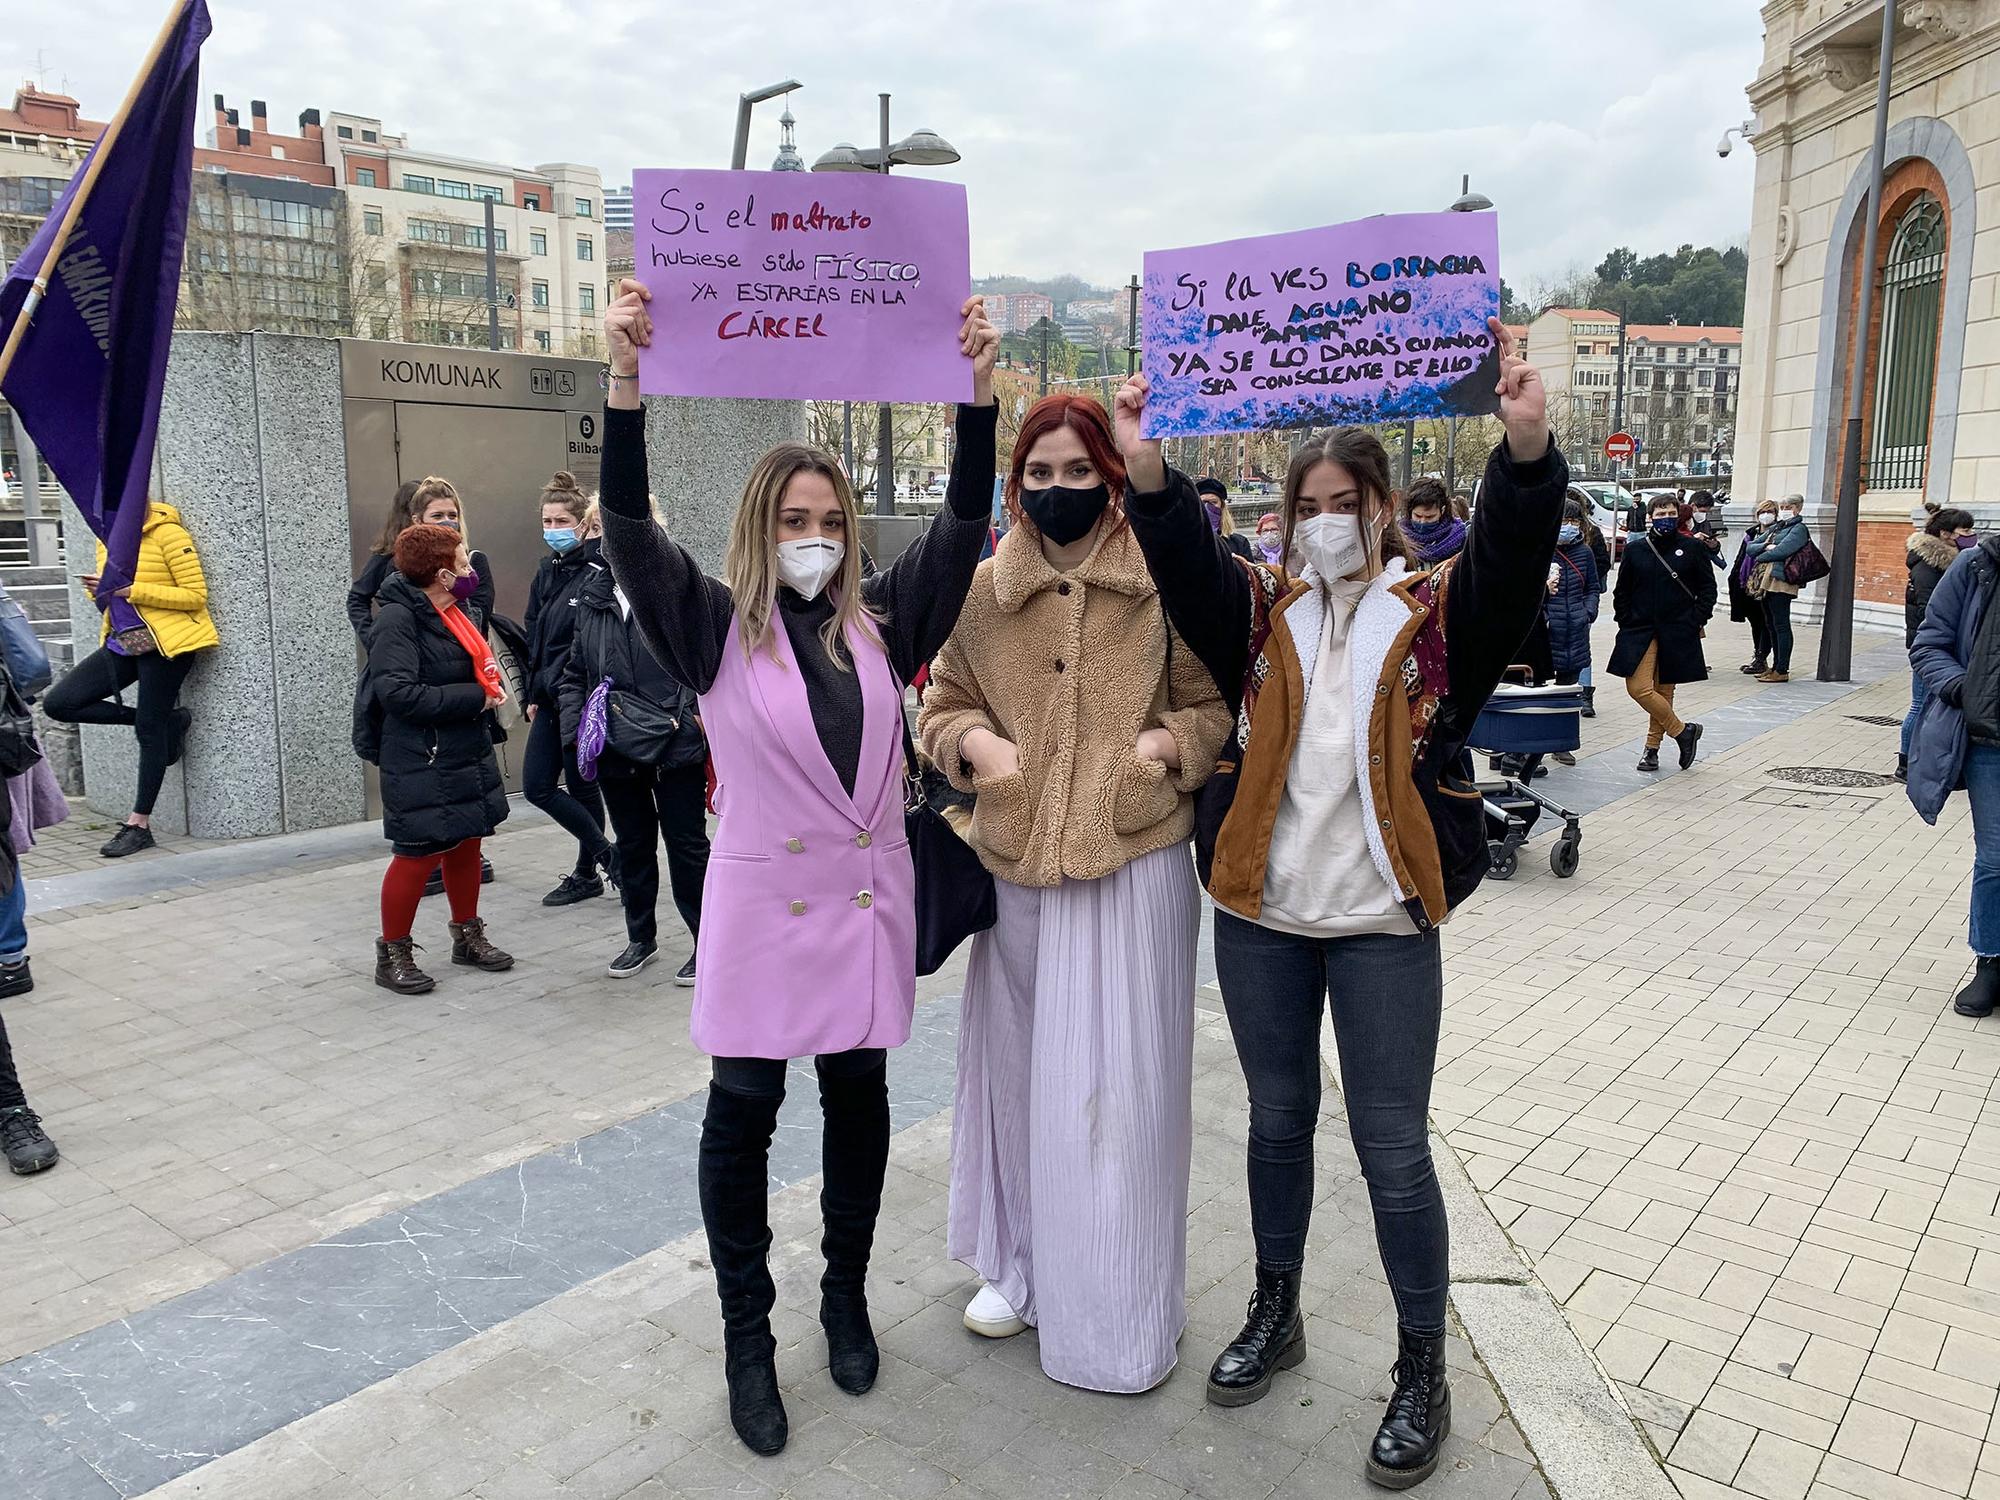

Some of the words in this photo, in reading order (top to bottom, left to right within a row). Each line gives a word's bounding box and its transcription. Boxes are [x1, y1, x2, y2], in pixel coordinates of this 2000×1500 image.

[651, 188, 709, 235] Si
[726, 194, 755, 228] el
[770, 201, 871, 232] maltrato
[651, 244, 741, 268] hubiese
[762, 252, 806, 272] sido
[692, 281, 718, 302] YA
[737, 282, 841, 303] ESTARÍAS
[851, 288, 876, 305] EN
[882, 289, 906, 305] LA
[1172, 273, 1207, 311] Si
[1225, 271, 1262, 300] la
[1346, 254, 1486, 289] BORRACHA
[1367, 290, 1412, 314] NO
[1167, 352, 1210, 377] YA
[1219, 350, 1254, 374] SE
[1269, 346, 1308, 368] LO
[1320, 332, 1400, 363] DARÁS
[381, 359, 502, 390] KOMUNAK
[1199, 376, 1238, 396] SEA
[1250, 362, 1384, 391] CONSCIENTE
[1394, 359, 1421, 378] DE
[568, 441, 603, 454] Bilba
